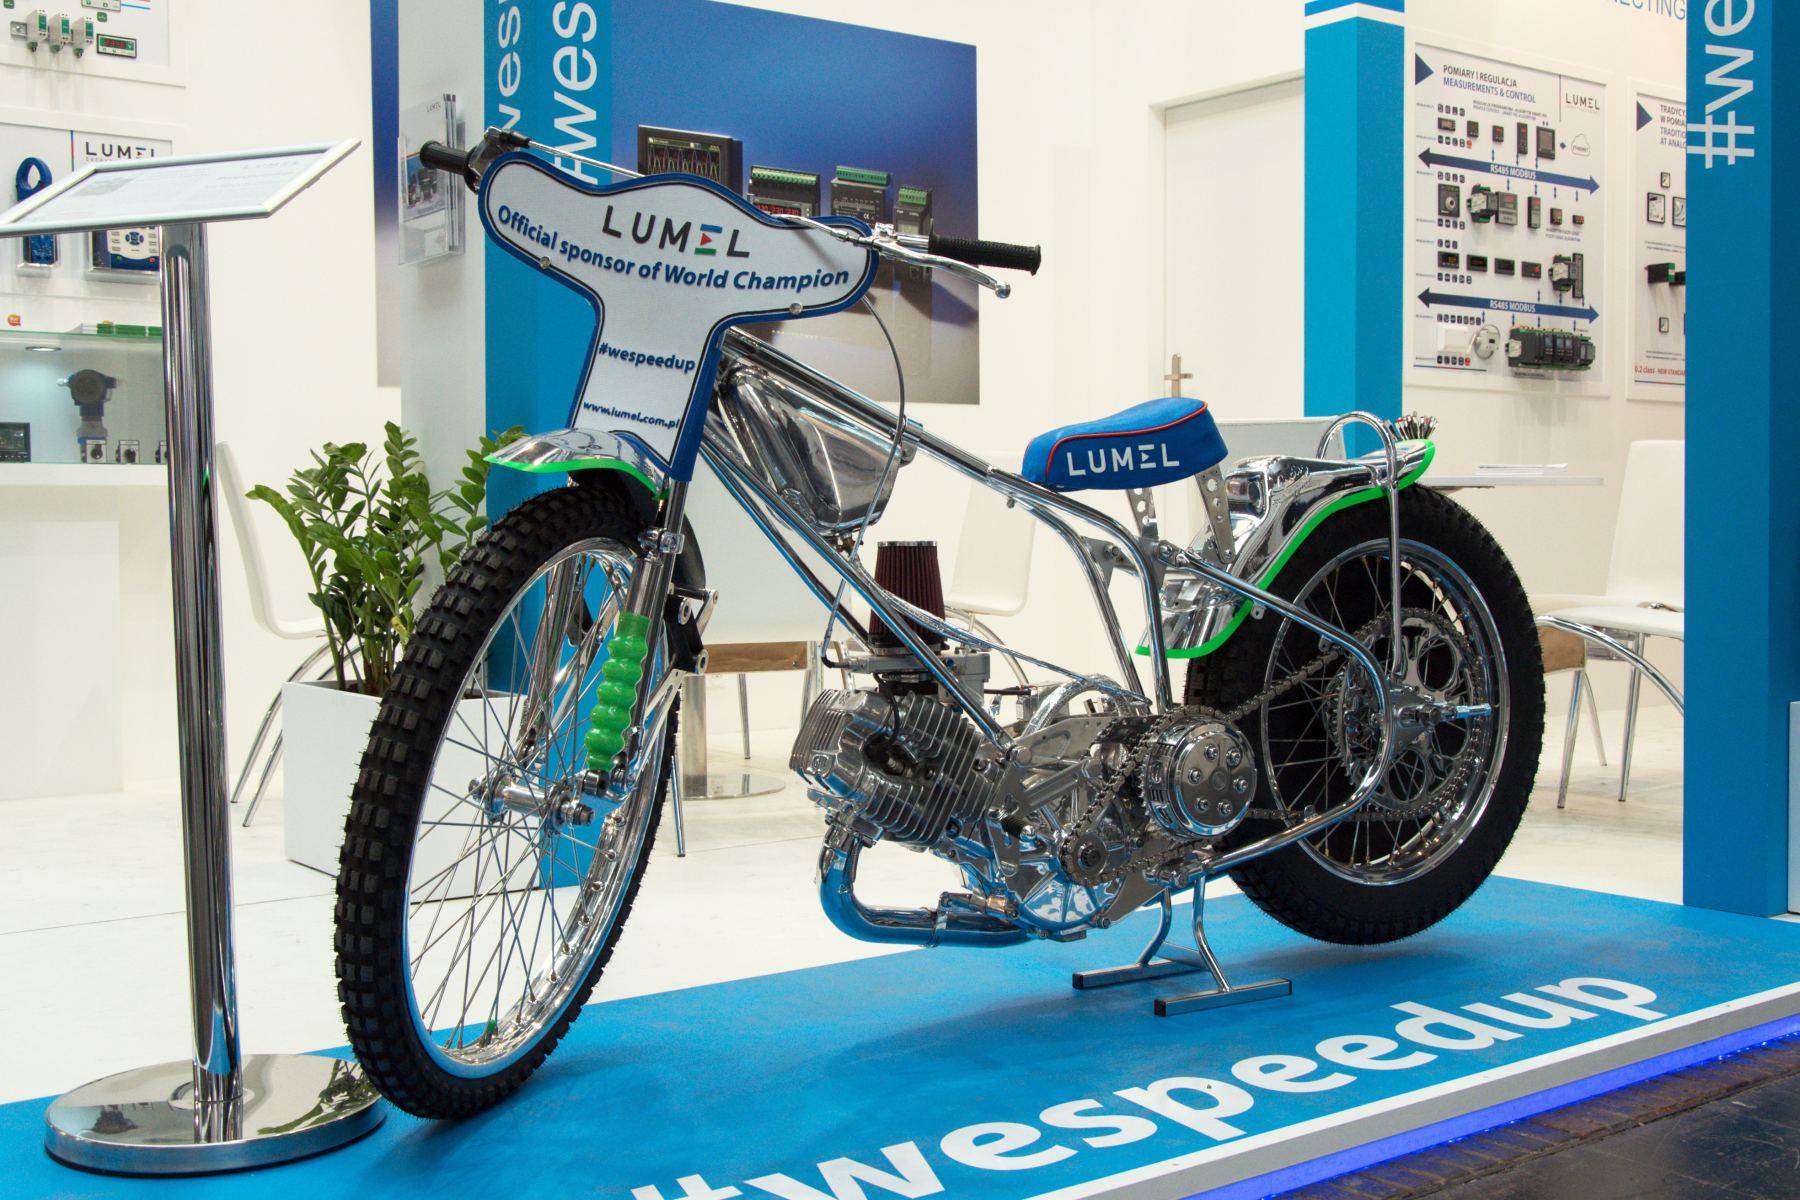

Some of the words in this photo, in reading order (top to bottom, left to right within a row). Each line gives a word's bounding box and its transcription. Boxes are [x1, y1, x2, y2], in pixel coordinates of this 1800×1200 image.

[1443, 64, 1475, 81] POMIARY
[1479, 72, 1518, 88] REGULACJA
[1687, 0, 1755, 169] #we
[1443, 77, 1499, 97] MEASUREMENTS
[1506, 89, 1536, 104] CONTROL
[1565, 92, 1601, 111] LUMEL
[1510, 166, 1537, 180] MODBUS
[602, 205, 749, 259] LUMEL
[498, 205, 558, 250] Official
[560, 239, 636, 276] sponsor
[638, 261, 663, 281] of
[665, 264, 730, 289] World
[732, 268, 850, 294] Champion
[1509, 301, 1536, 313] MODBUS
[599, 342, 696, 375] #wespeedup
[583, 401, 680, 429] www.lumel.com.pl
[1066, 443, 1180, 477] LUMEL
